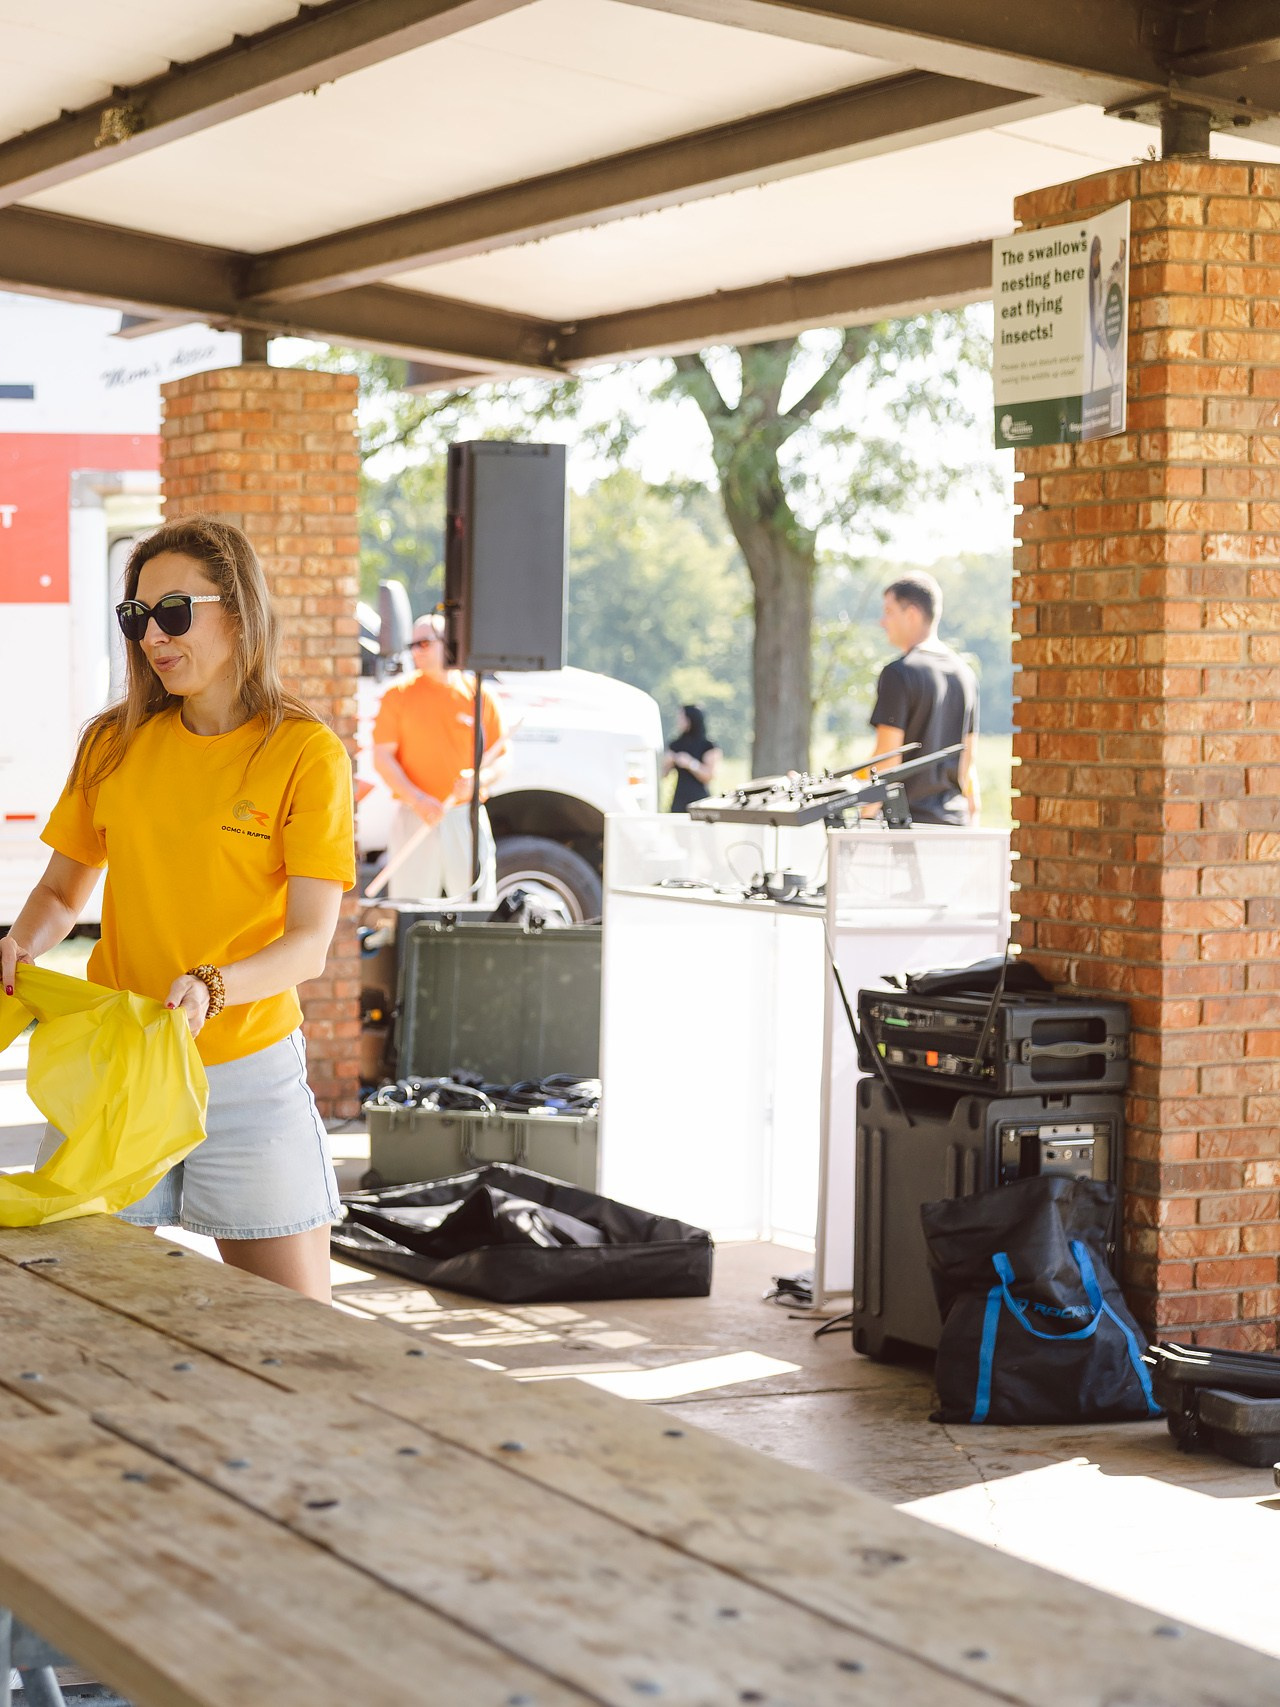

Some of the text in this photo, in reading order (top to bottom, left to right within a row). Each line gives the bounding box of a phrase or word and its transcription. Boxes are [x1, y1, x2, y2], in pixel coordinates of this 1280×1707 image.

[1001, 239, 1088, 266] The swallows
[1001, 268, 1085, 293] nesting here
[1001, 295, 1063, 319] eat flying
[1001, 323, 1054, 345] insects!
[221, 825, 242, 834] OCMC
[247, 830, 271, 840] RAPTOR
